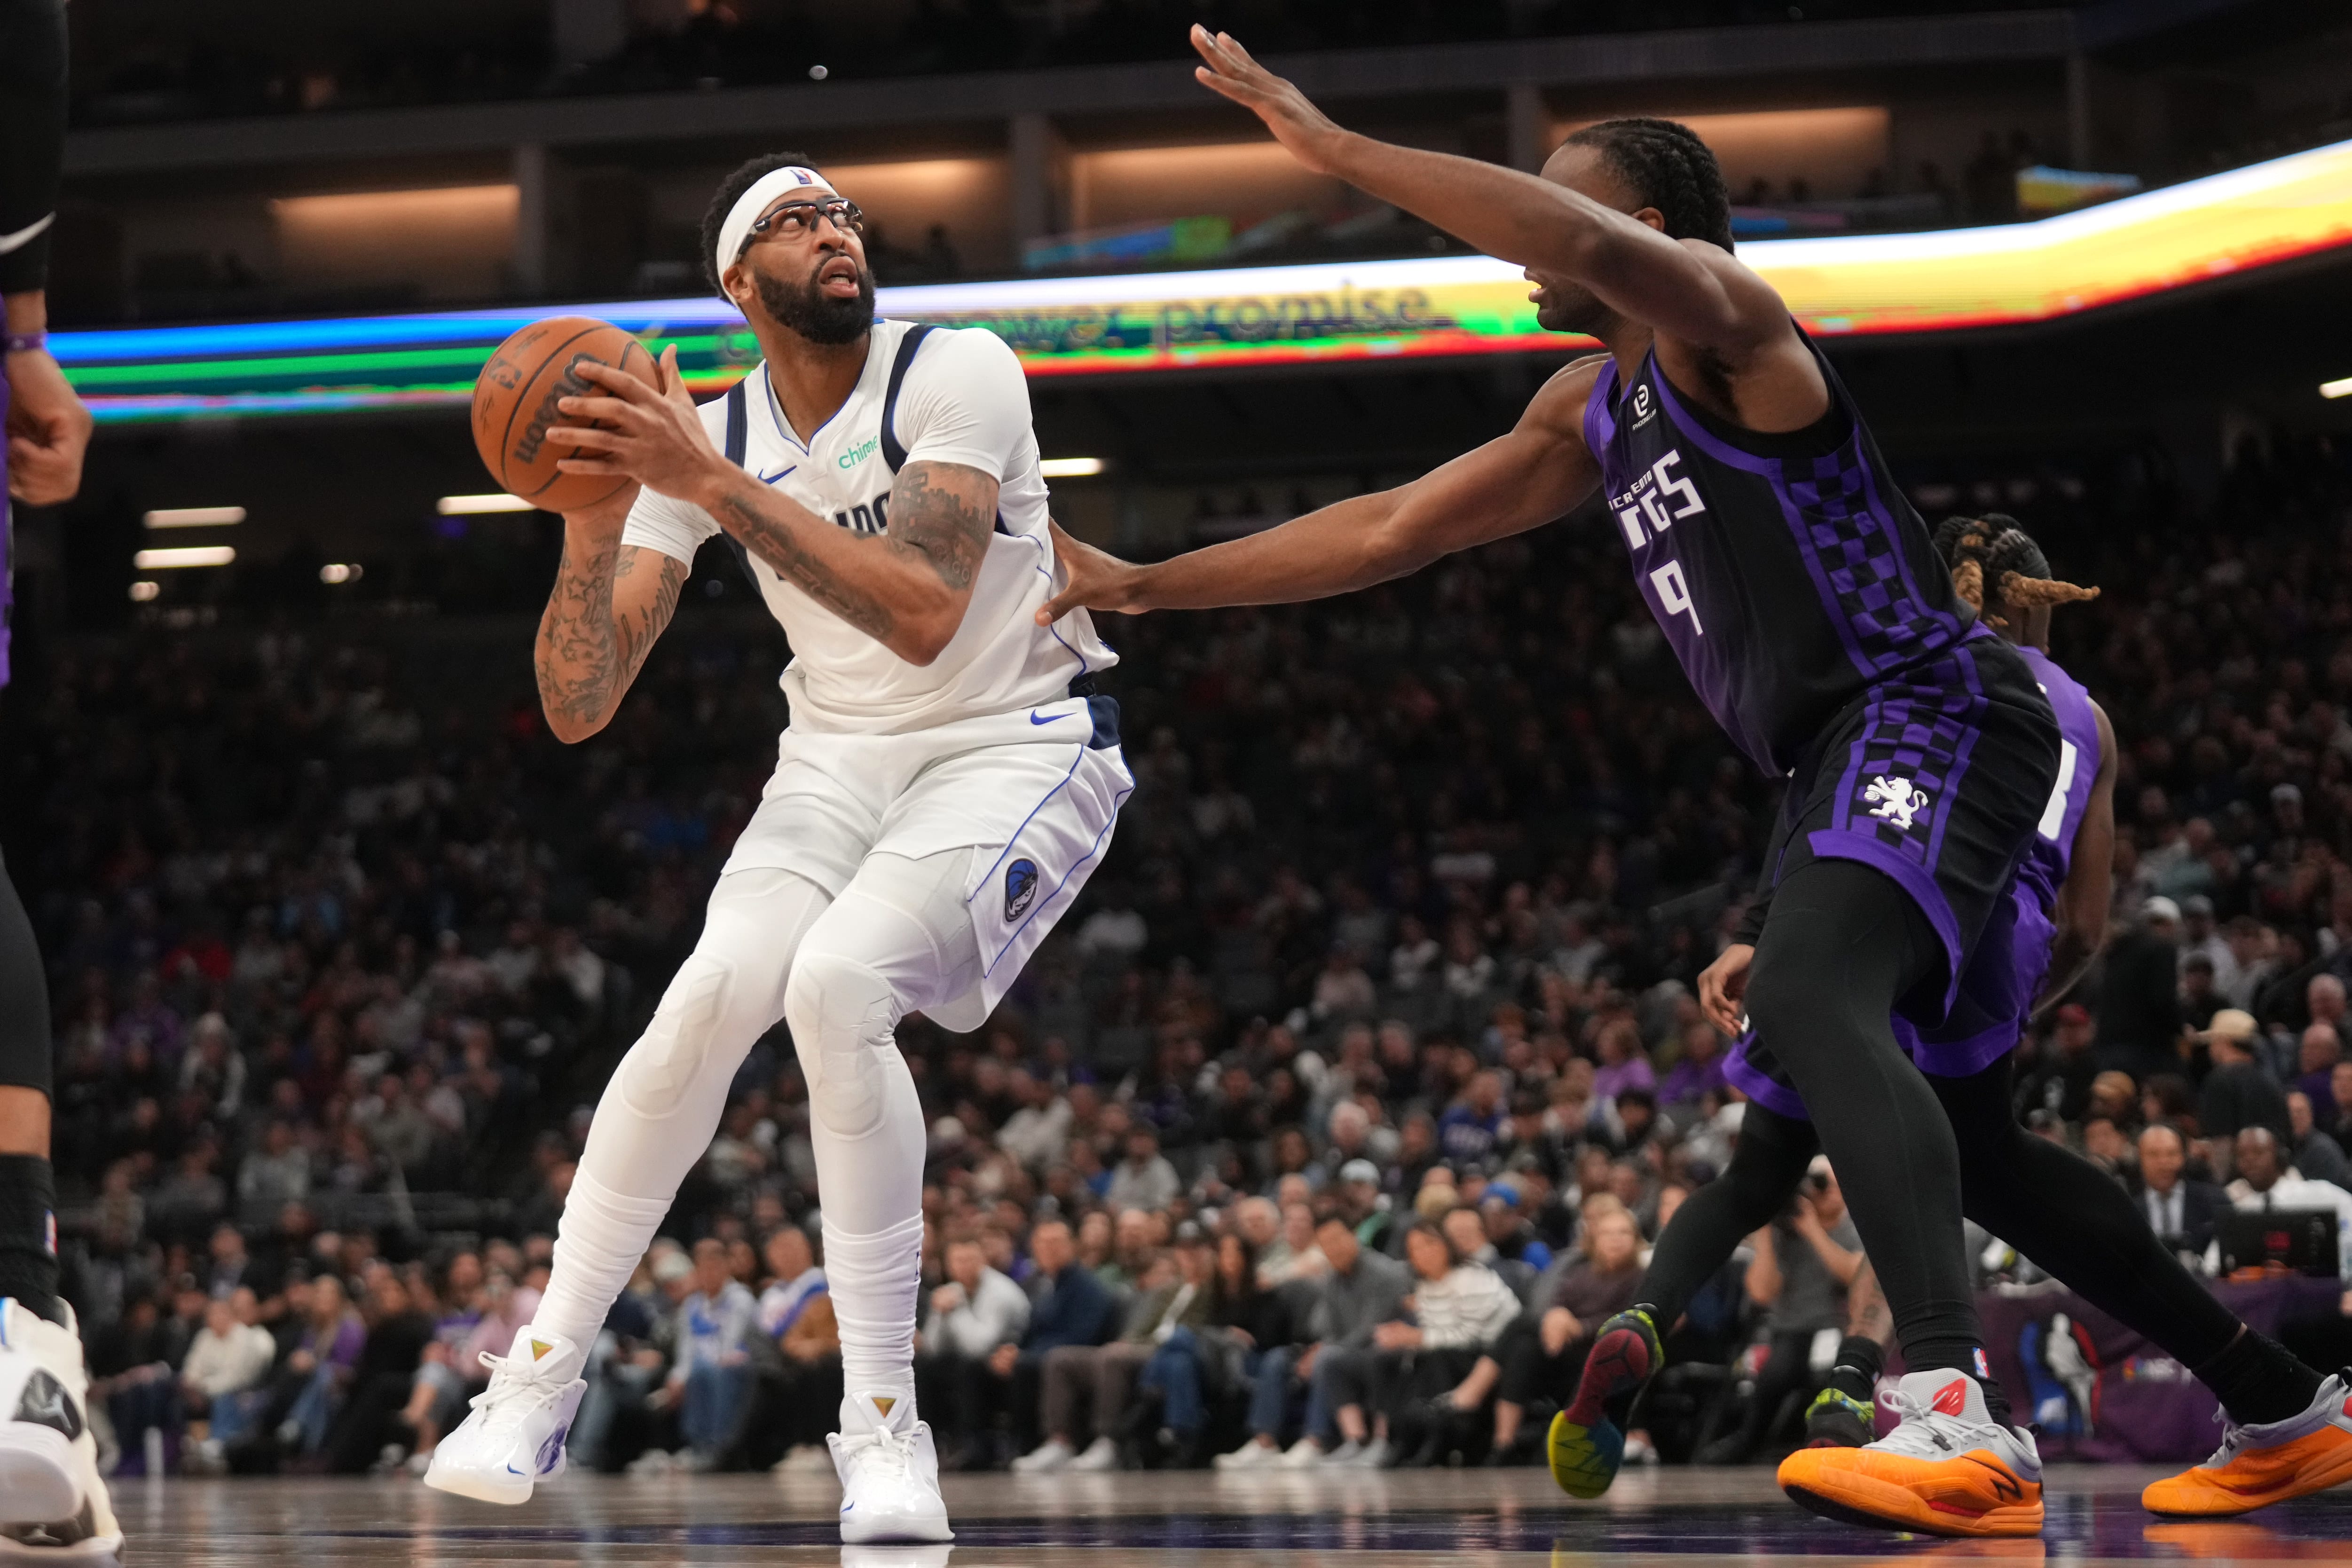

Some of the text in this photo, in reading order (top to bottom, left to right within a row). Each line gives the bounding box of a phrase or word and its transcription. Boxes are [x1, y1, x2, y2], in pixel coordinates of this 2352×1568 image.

[1153, 278, 1430, 352] promise
[838, 434, 878, 469] chime
[1649, 559, 1704, 636] 9
